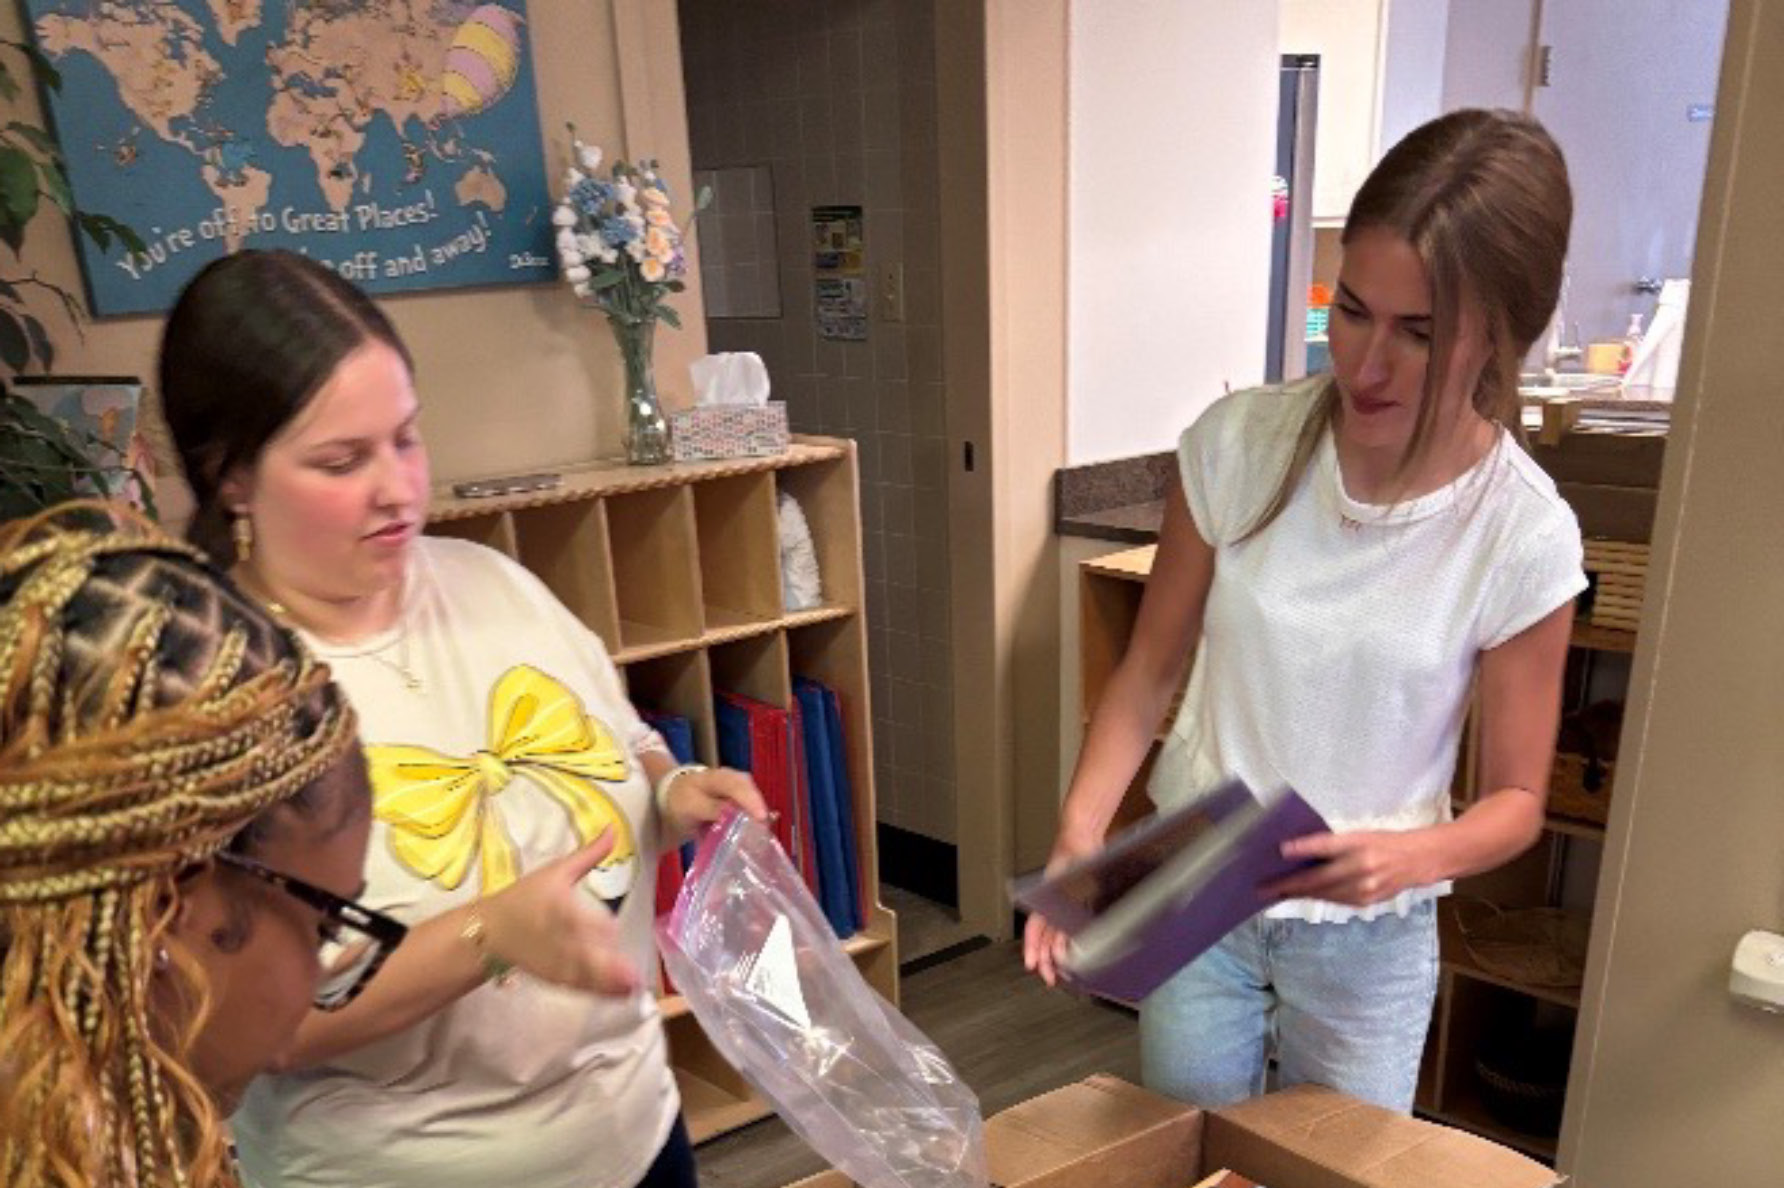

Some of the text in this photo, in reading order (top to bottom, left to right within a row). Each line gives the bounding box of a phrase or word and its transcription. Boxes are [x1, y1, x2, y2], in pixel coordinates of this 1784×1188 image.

[280, 206, 350, 234] Great
[354, 189, 440, 231] Places!
[338, 251, 379, 280] off
[384, 244, 429, 279] and
[430, 210, 494, 267] away!
